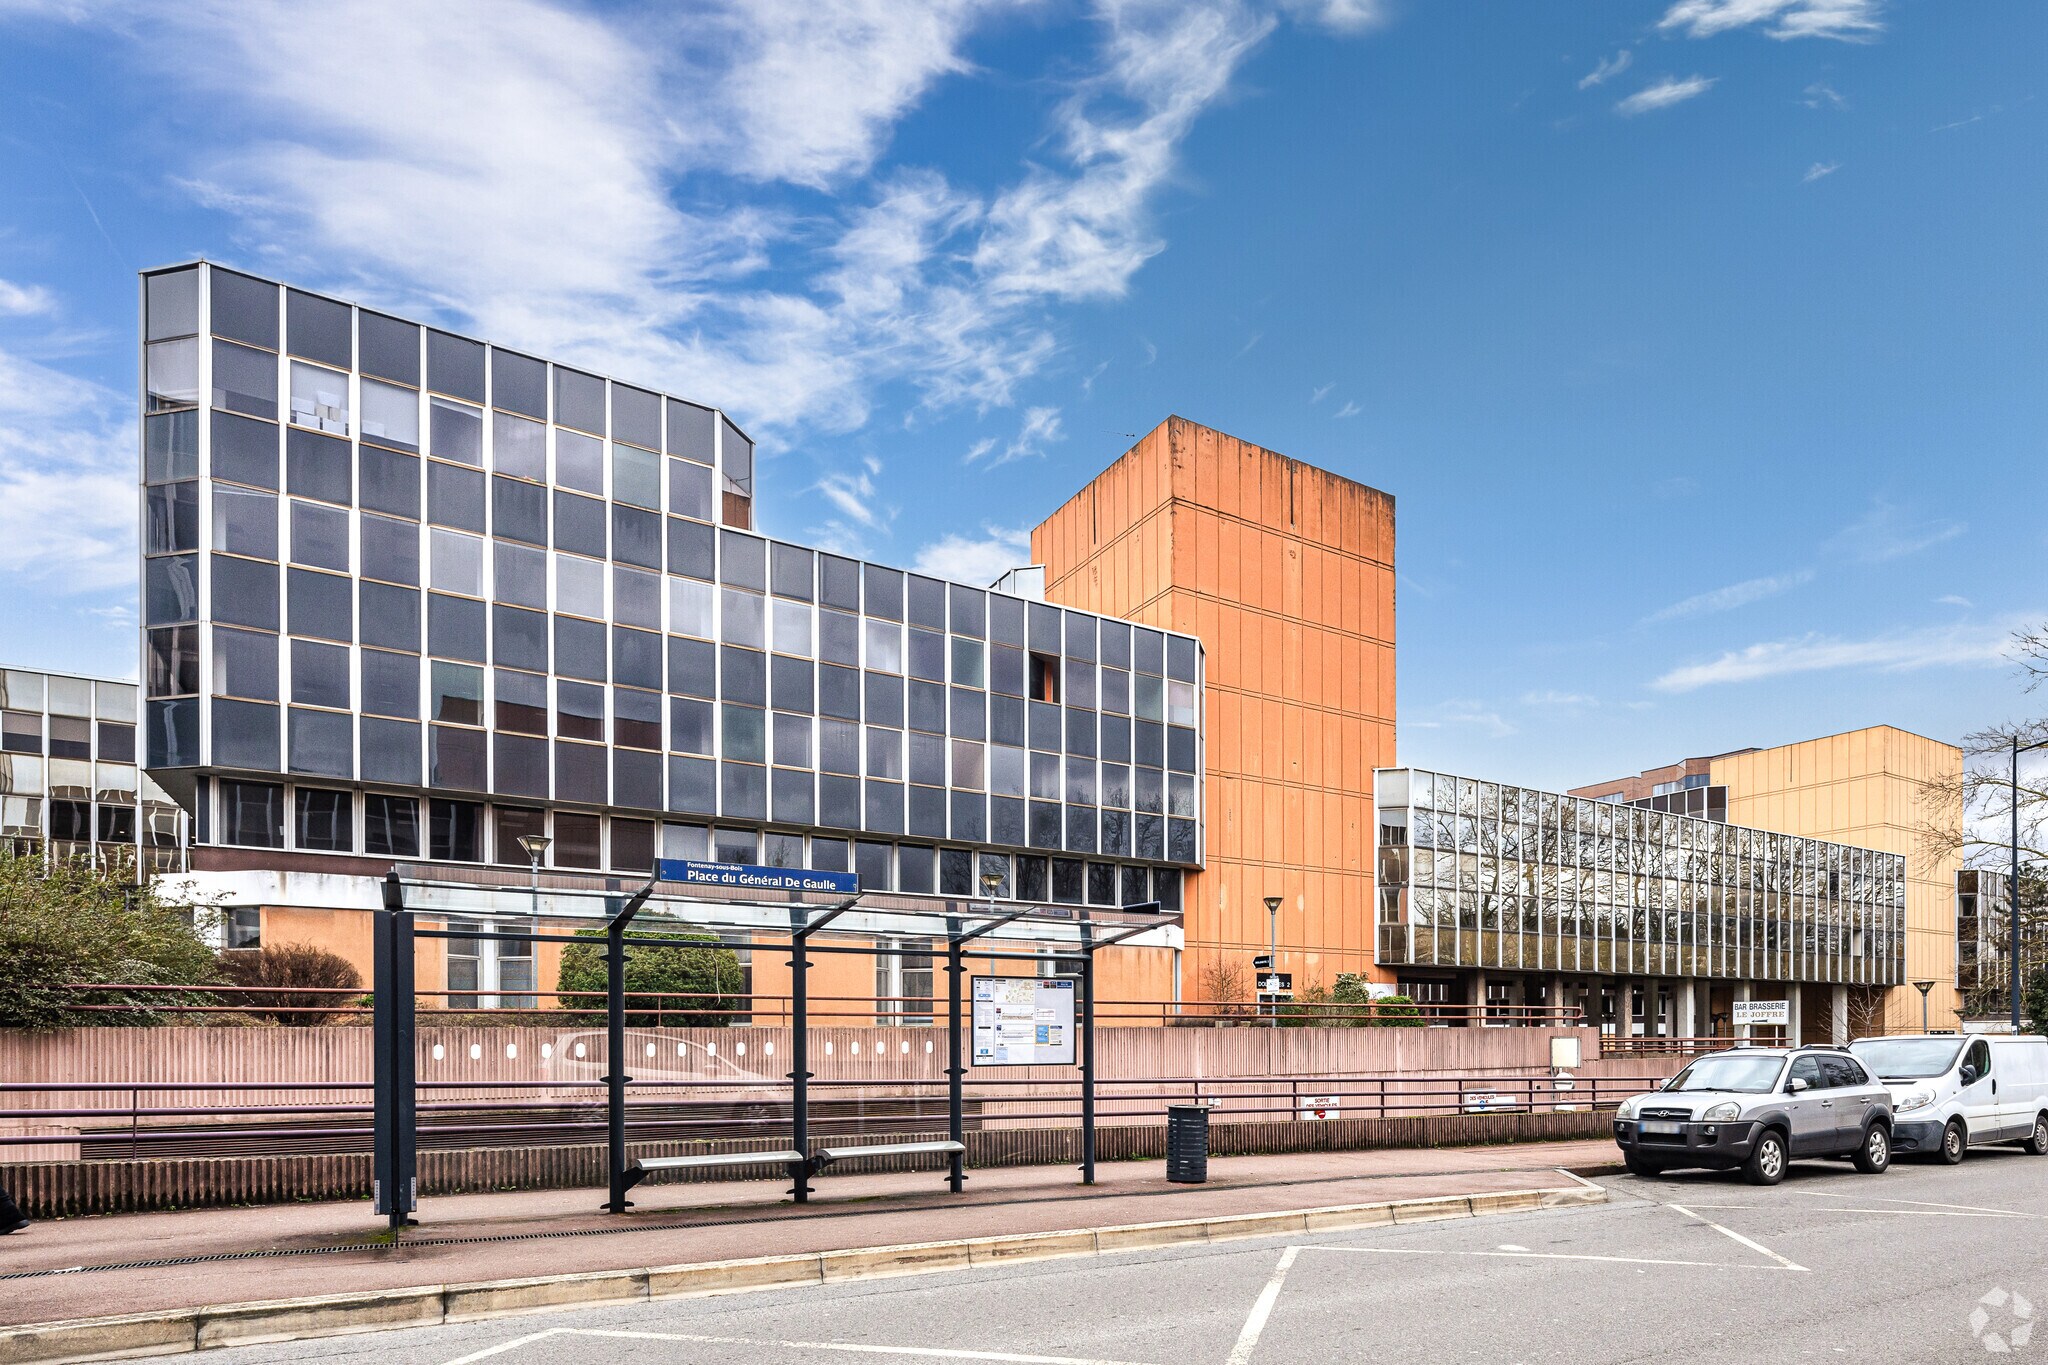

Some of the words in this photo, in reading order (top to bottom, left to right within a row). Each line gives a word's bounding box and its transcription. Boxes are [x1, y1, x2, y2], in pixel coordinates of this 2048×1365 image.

[687, 861, 743, 871] Fontenay-sous-Bois
[687, 870, 718, 882] Place
[721, 872, 736, 883] du
[739, 874, 782, 886] Général
[785, 877, 800, 887] De
[803, 879, 836, 890] Gaulle
[1734, 1003, 1747, 1011] BAR
[1749, 1002, 1786, 1010] BRASSERIE
